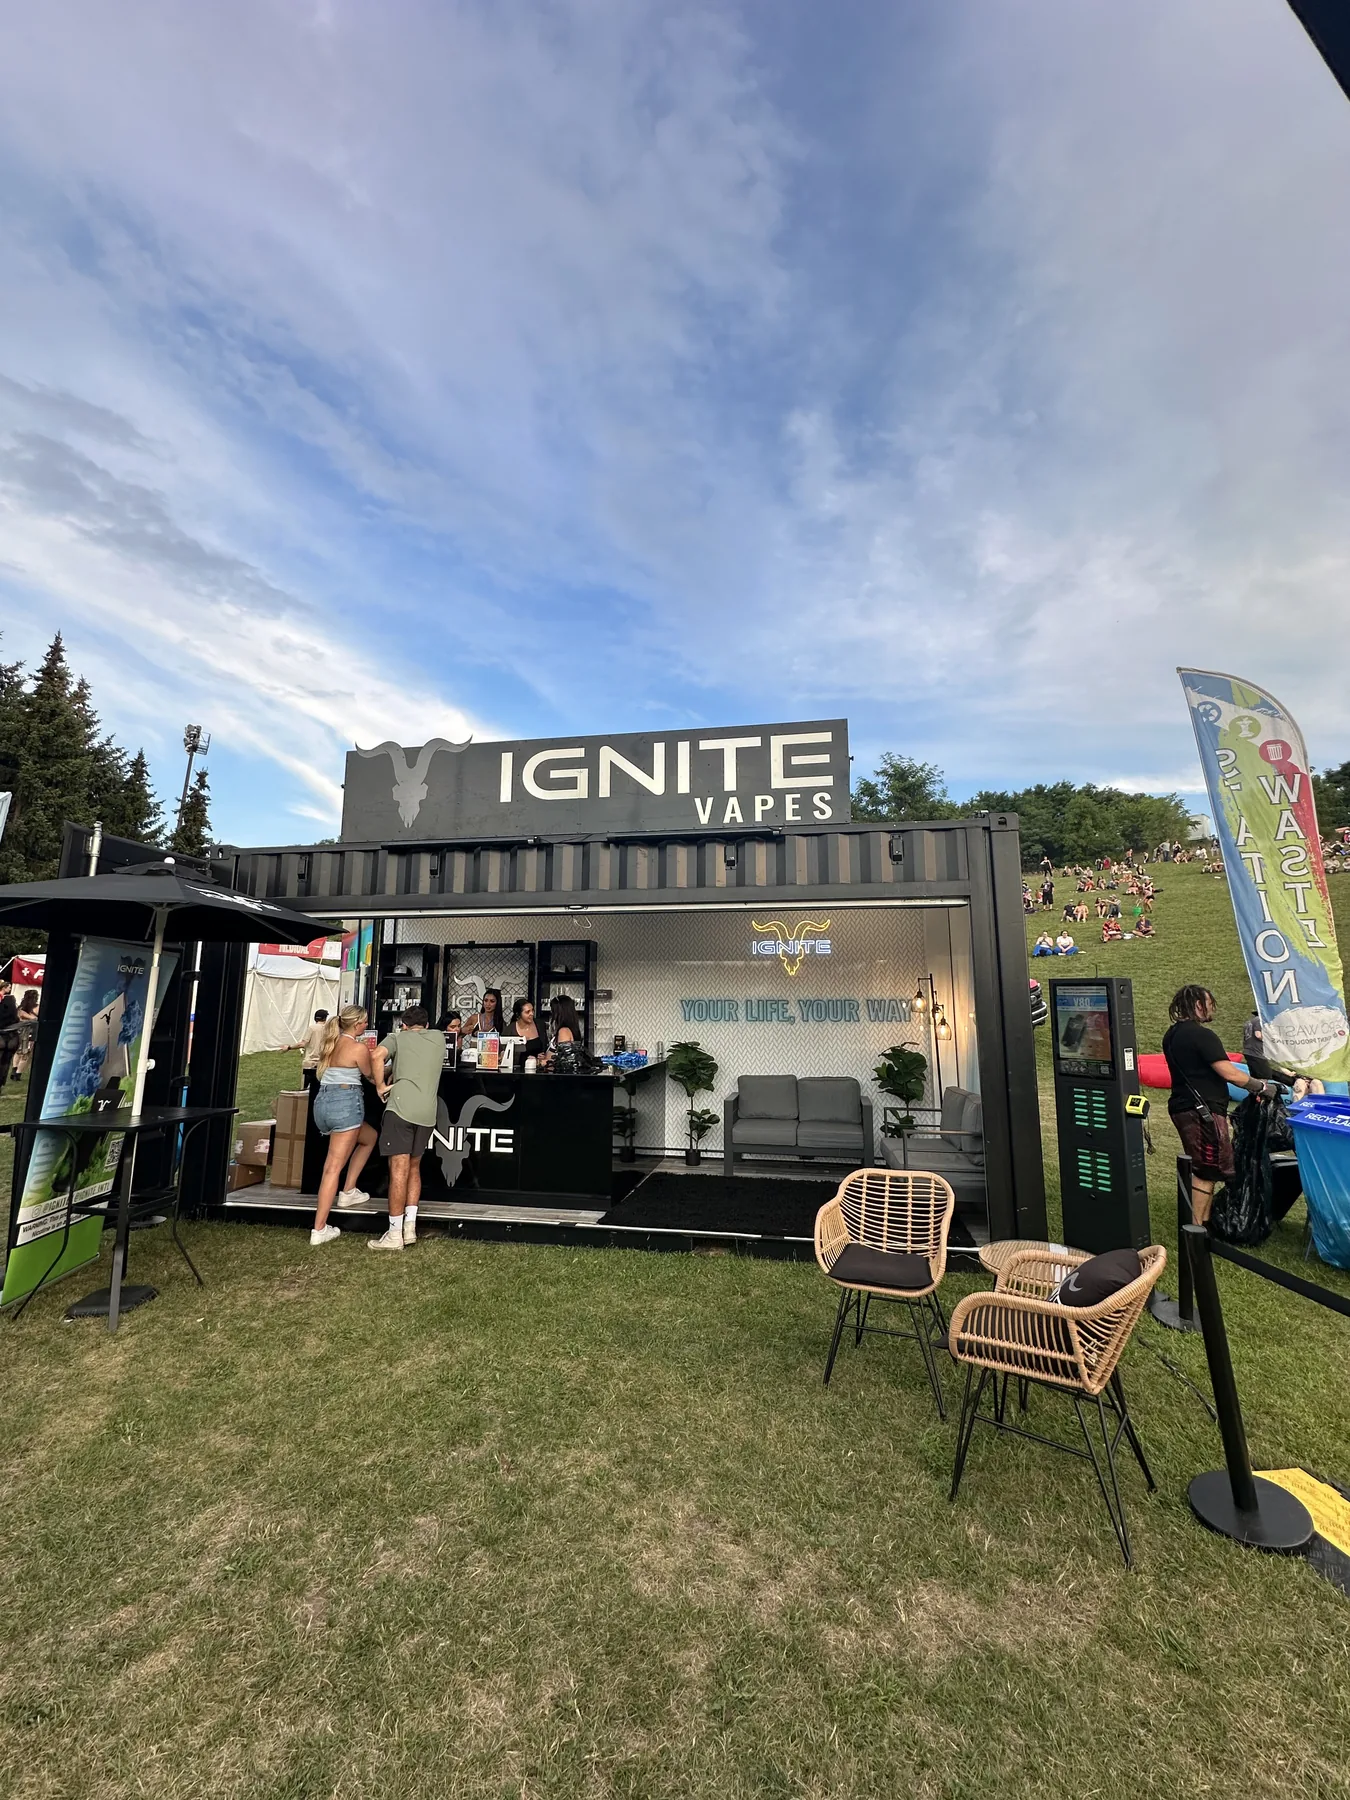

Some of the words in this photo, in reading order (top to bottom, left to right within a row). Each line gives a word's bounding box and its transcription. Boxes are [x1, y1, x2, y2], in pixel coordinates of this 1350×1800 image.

[499, 731, 834, 803] IGNITE
[694, 792, 833, 825] VAPES
[751, 939, 832, 955] IGNITE
[75, 944, 101, 992] WAY
[117, 963, 145, 976] IGNITE
[451, 994, 526, 1009] IGNTE
[681, 999, 739, 1022] YOUR
[745, 999, 796, 1025] LIFE,
[798, 999, 860, 1022] YOUR
[866, 999, 914, 1022] WAY
[58, 1000, 89, 1065] YOUR
[46, 1080, 71, 1115] IFE
[427, 1126, 515, 1154] NITE
